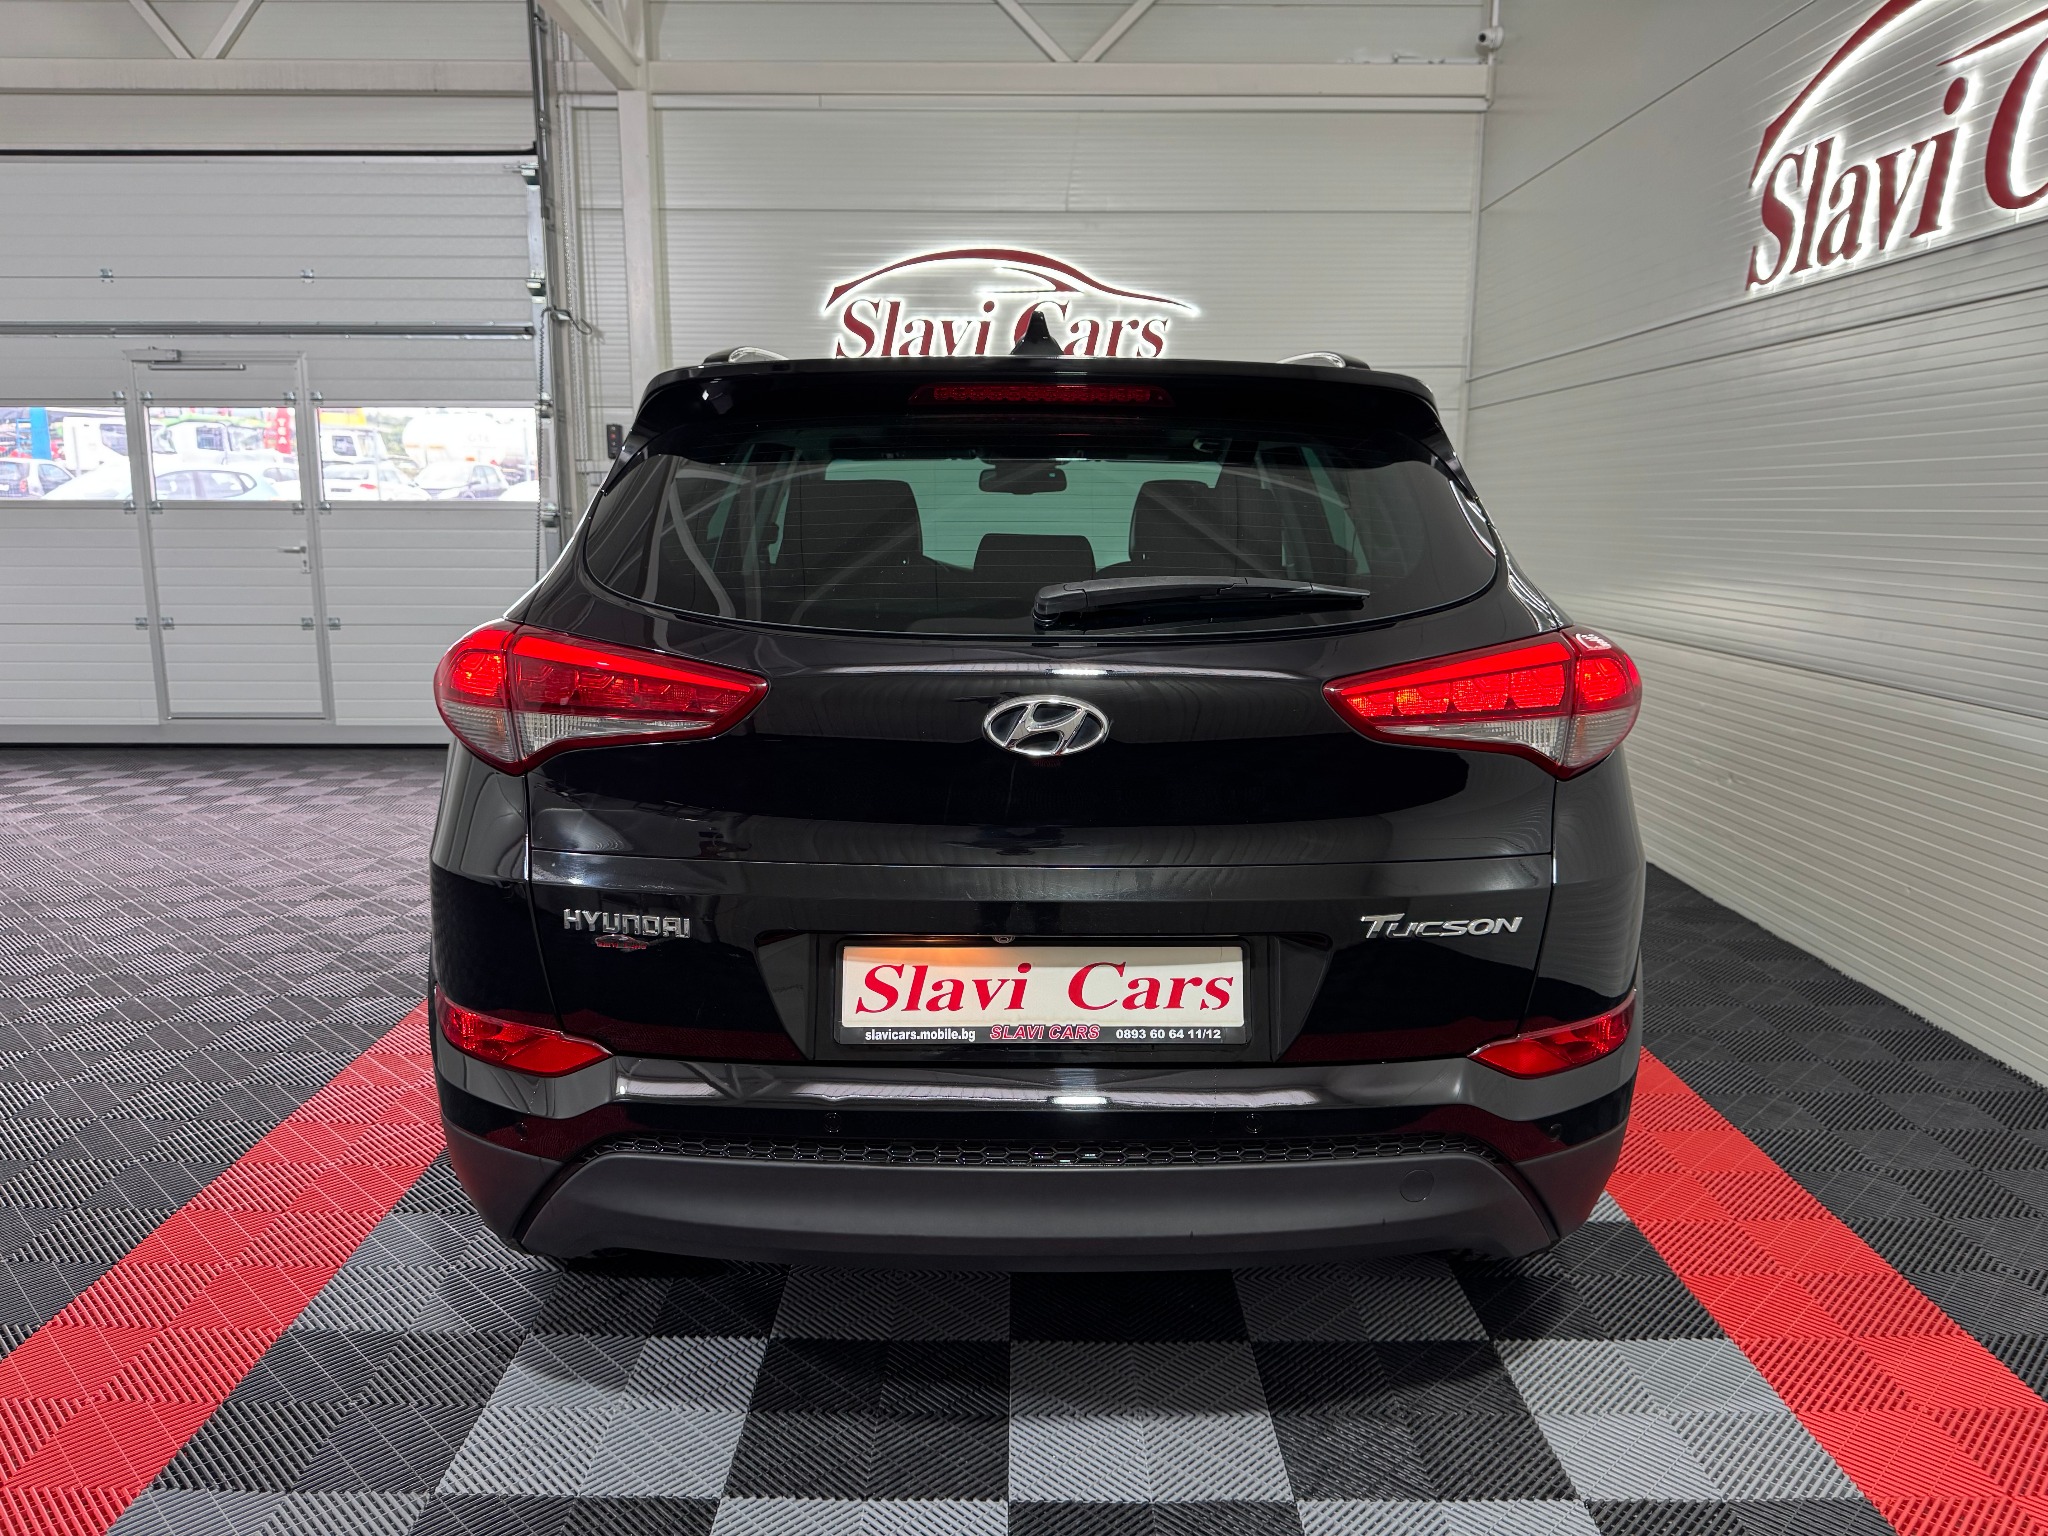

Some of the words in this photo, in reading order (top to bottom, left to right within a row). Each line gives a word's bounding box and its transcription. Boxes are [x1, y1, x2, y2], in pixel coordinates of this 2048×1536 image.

[1745, 77, 1968, 291] Slavi
[836, 299, 995, 357] Slavi
[856, 962, 1031, 1014] Slavi
[1067, 961, 1234, 1013] Cars
[865, 1028, 976, 1042] slavicars.mobile.bg
[990, 1024, 1045, 1040] SLAVI
[1048, 1024, 1101, 1040] CARS
[1116, 1028, 1147, 1039] 0893
[1150, 1028, 1166, 1039] 60
[1168, 1028, 1185, 1039] 64
[1187, 1028, 1222, 1039] 11/12
